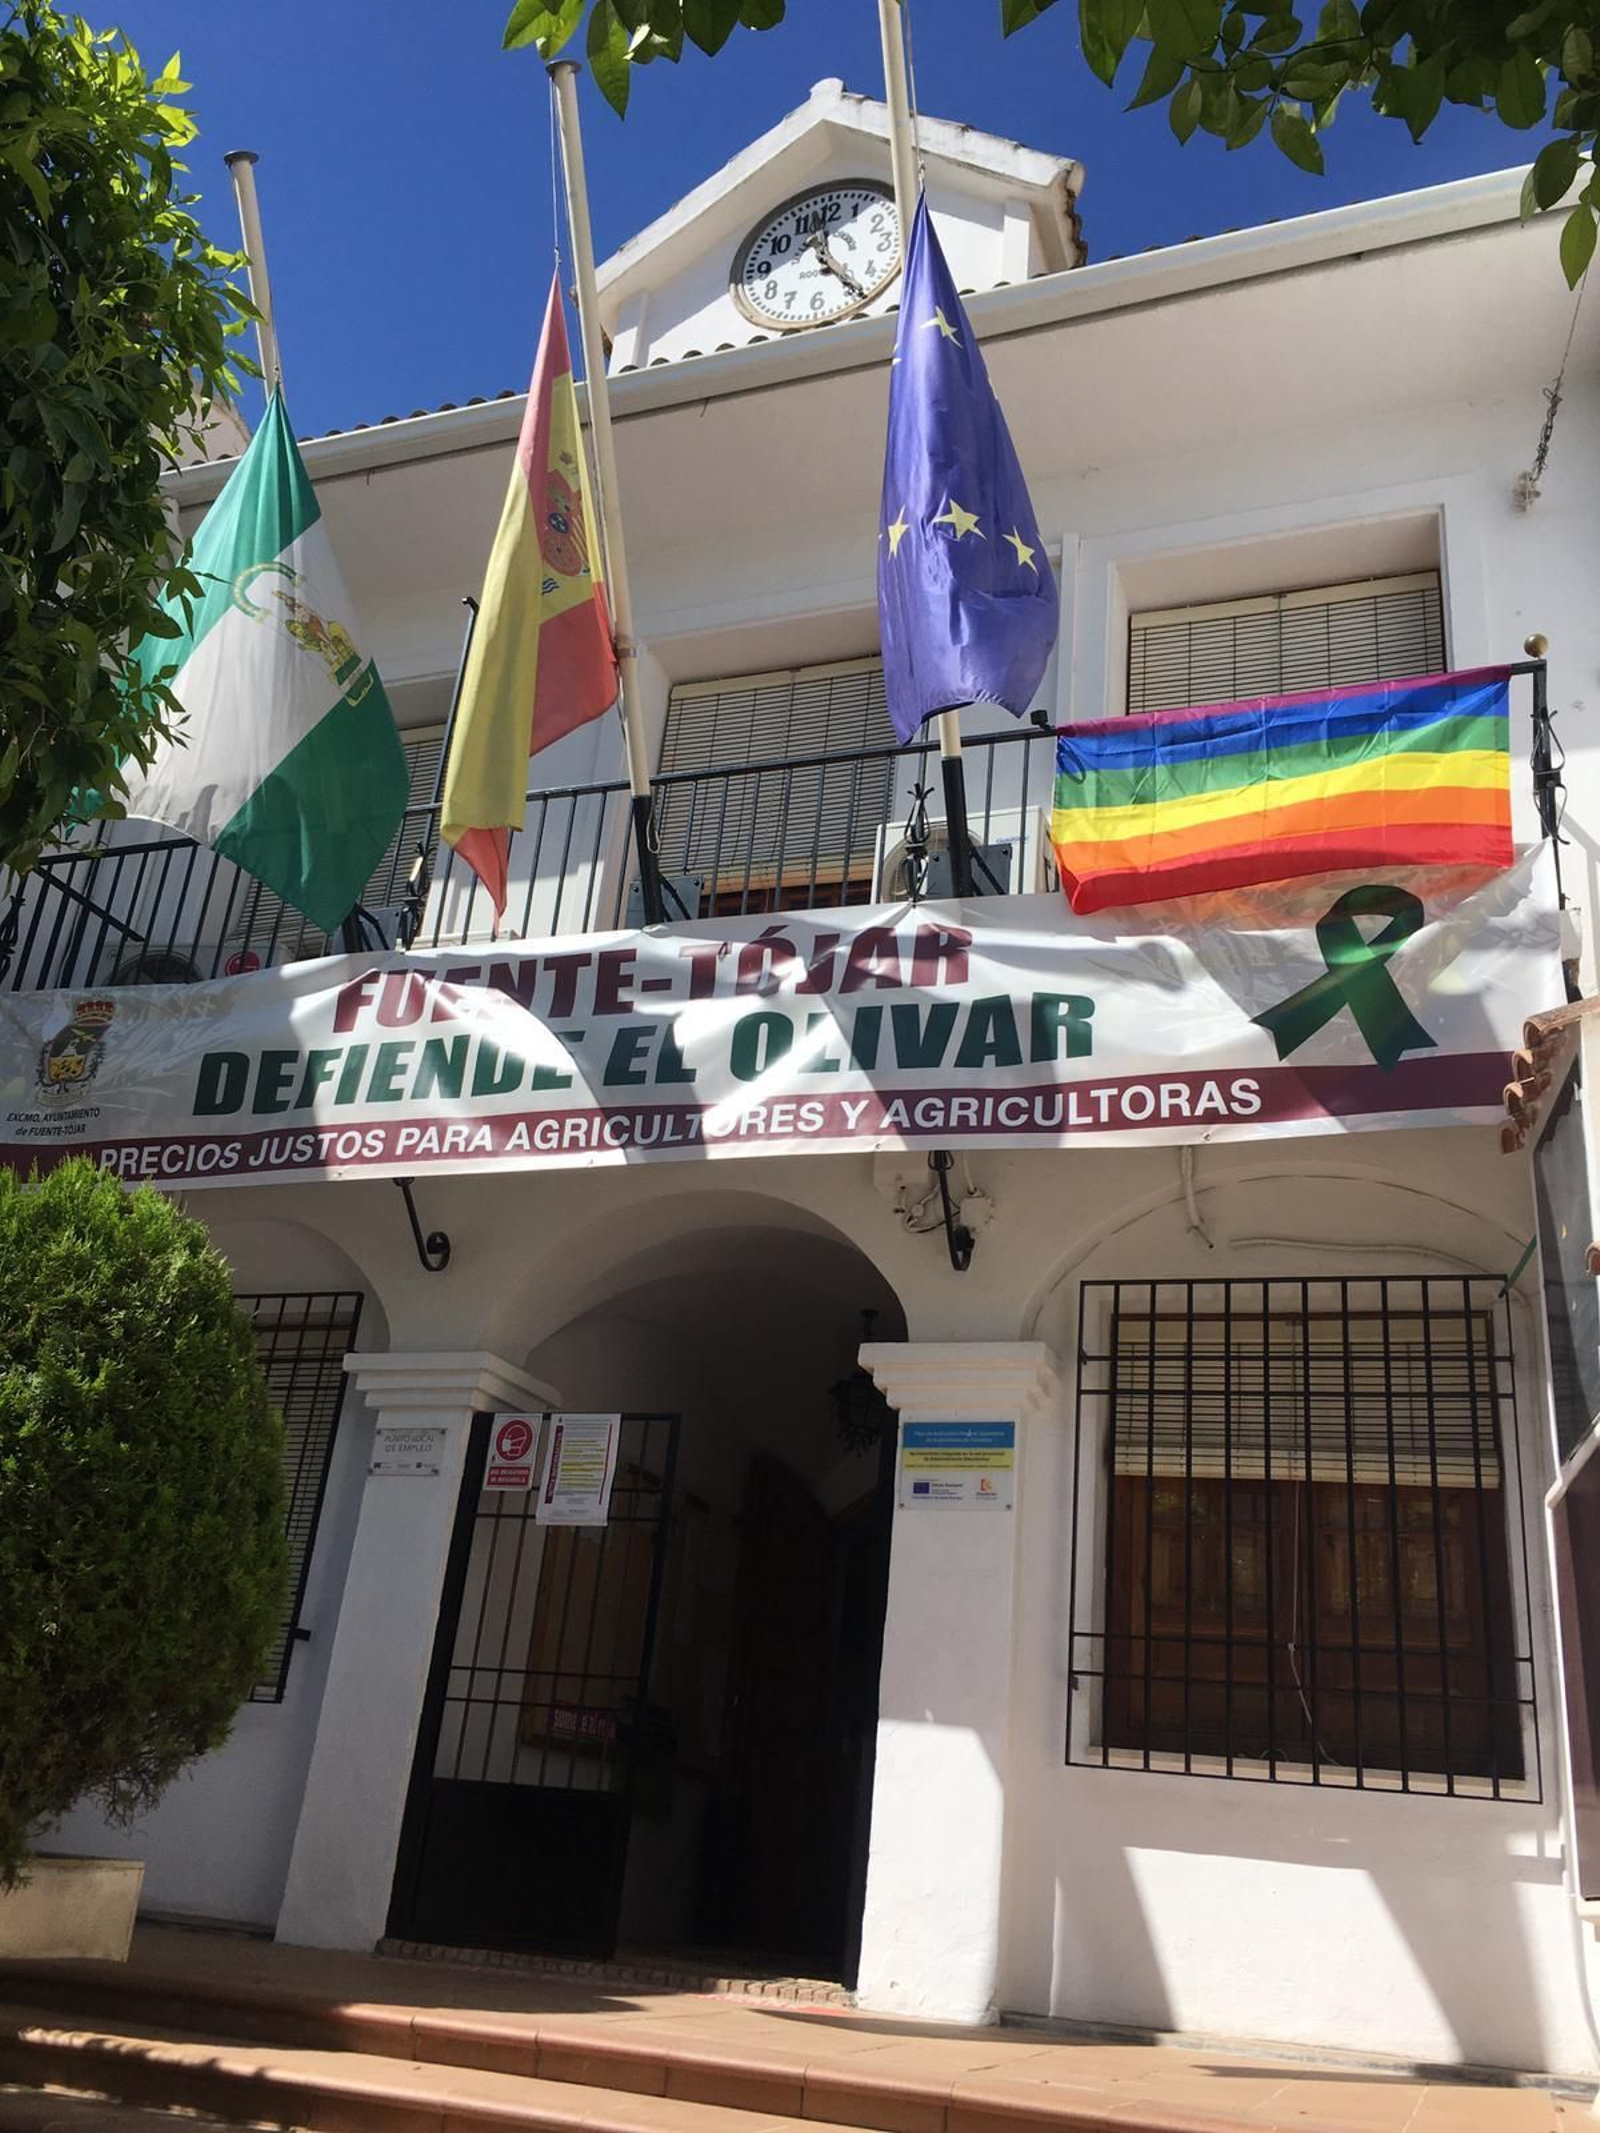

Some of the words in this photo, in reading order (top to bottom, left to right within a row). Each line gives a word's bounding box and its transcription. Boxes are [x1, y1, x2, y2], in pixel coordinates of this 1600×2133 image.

[821, 202, 842, 223] 12
[851, 203, 859, 218] 1
[794, 214, 810, 235] 11
[869, 213, 885, 234] 2
[769, 234, 792, 256] 10
[876, 232, 892, 252] 3
[757, 261, 772, 281] 9
[865, 259, 877, 278] 4
[764, 280, 778, 300] 8
[784, 291, 797, 309] 7
[810, 291, 825, 311] 6
[333, 924, 973, 1033] FUENTE-TÓJAR
[193, 1030, 586, 1117] DEFIENDE
[603, 1023, 697, 1087] EL
[730, 991, 1094, 1082] OLIVAR
[42, 1107, 101, 1122] AYUNTAMIENTO
[100, 1141, 243, 1177] PRECIOS
[248, 1128, 384, 1165] JUSTOS
[395, 1117, 494, 1156] PARA
[504, 1100, 824, 1152] AGRICULTORES
[840, 1100, 870, 1131] Y
[879, 1077, 1262, 1130] AGRICULTORAS
